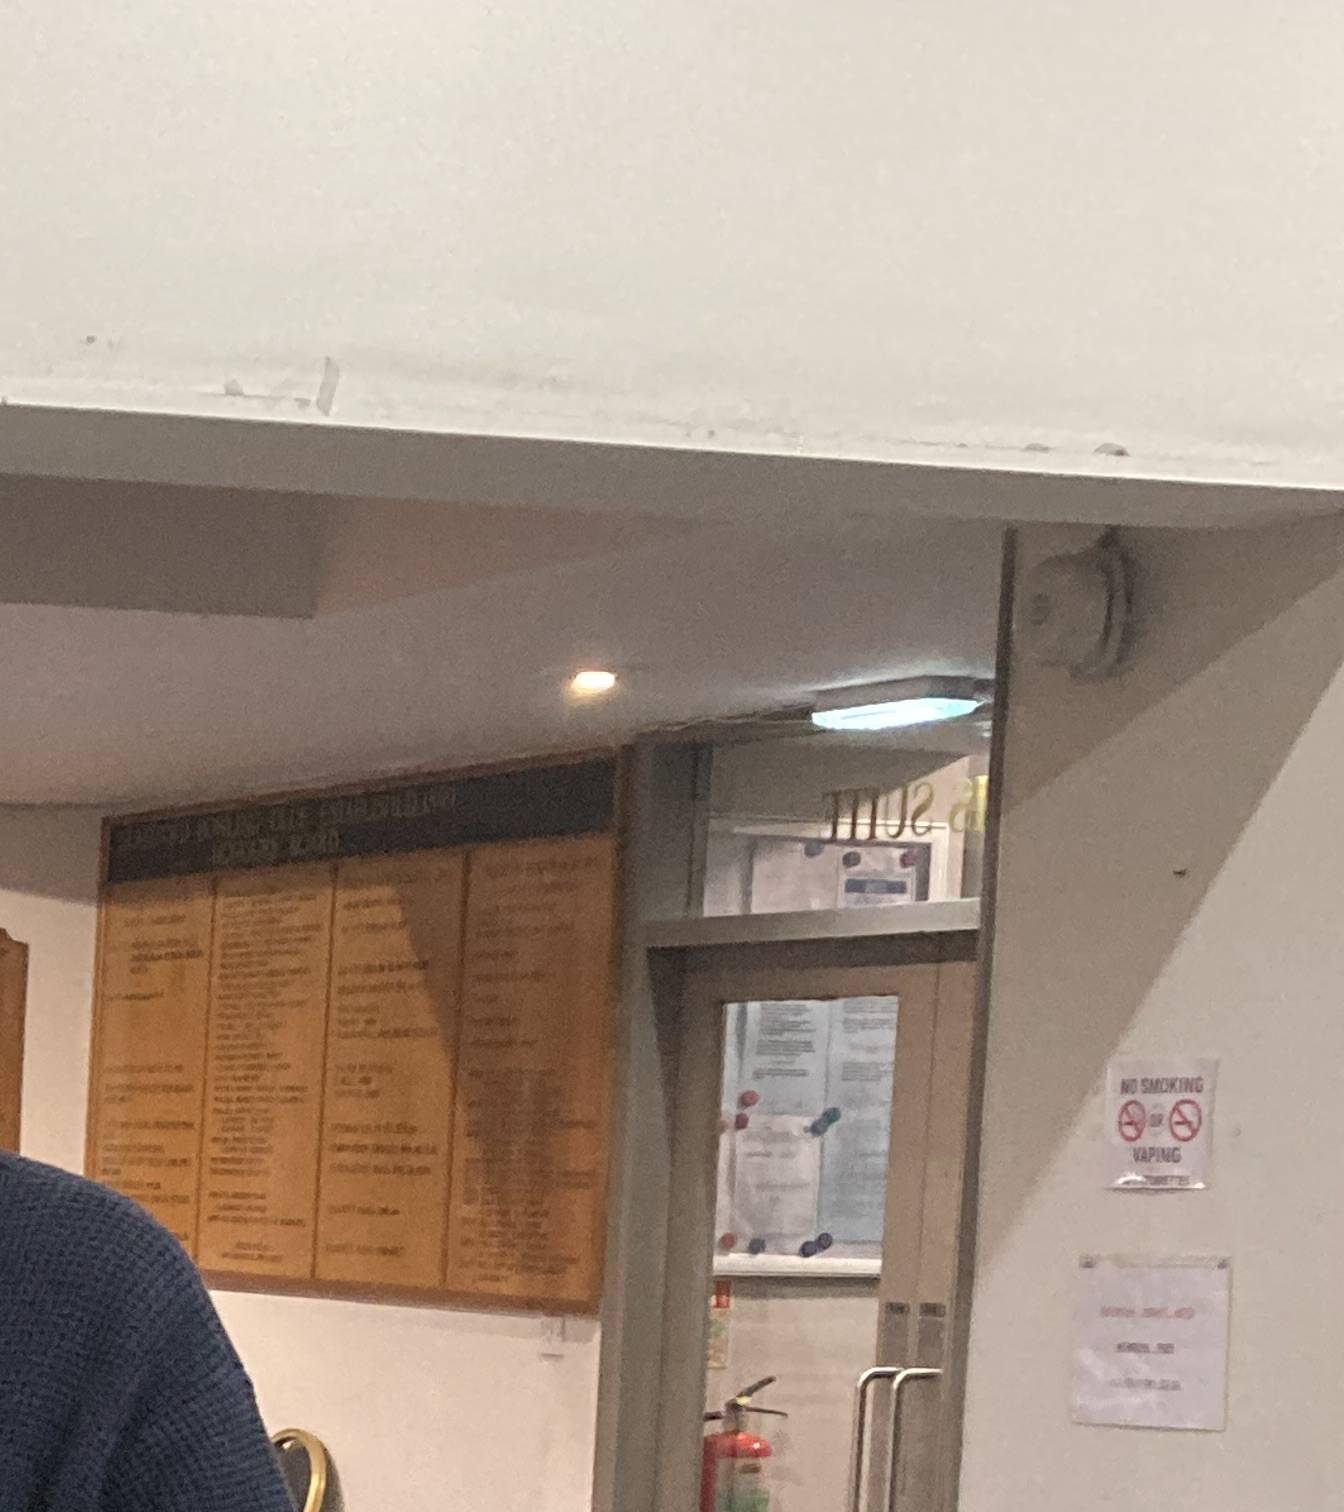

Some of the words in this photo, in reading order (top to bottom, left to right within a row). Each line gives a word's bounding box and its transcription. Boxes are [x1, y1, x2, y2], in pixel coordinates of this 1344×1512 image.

[1120, 1078, 1138, 1096] NO
[1141, 1076, 1204, 1095] SMOKING
[1132, 1147, 1182, 1163] VAPING
